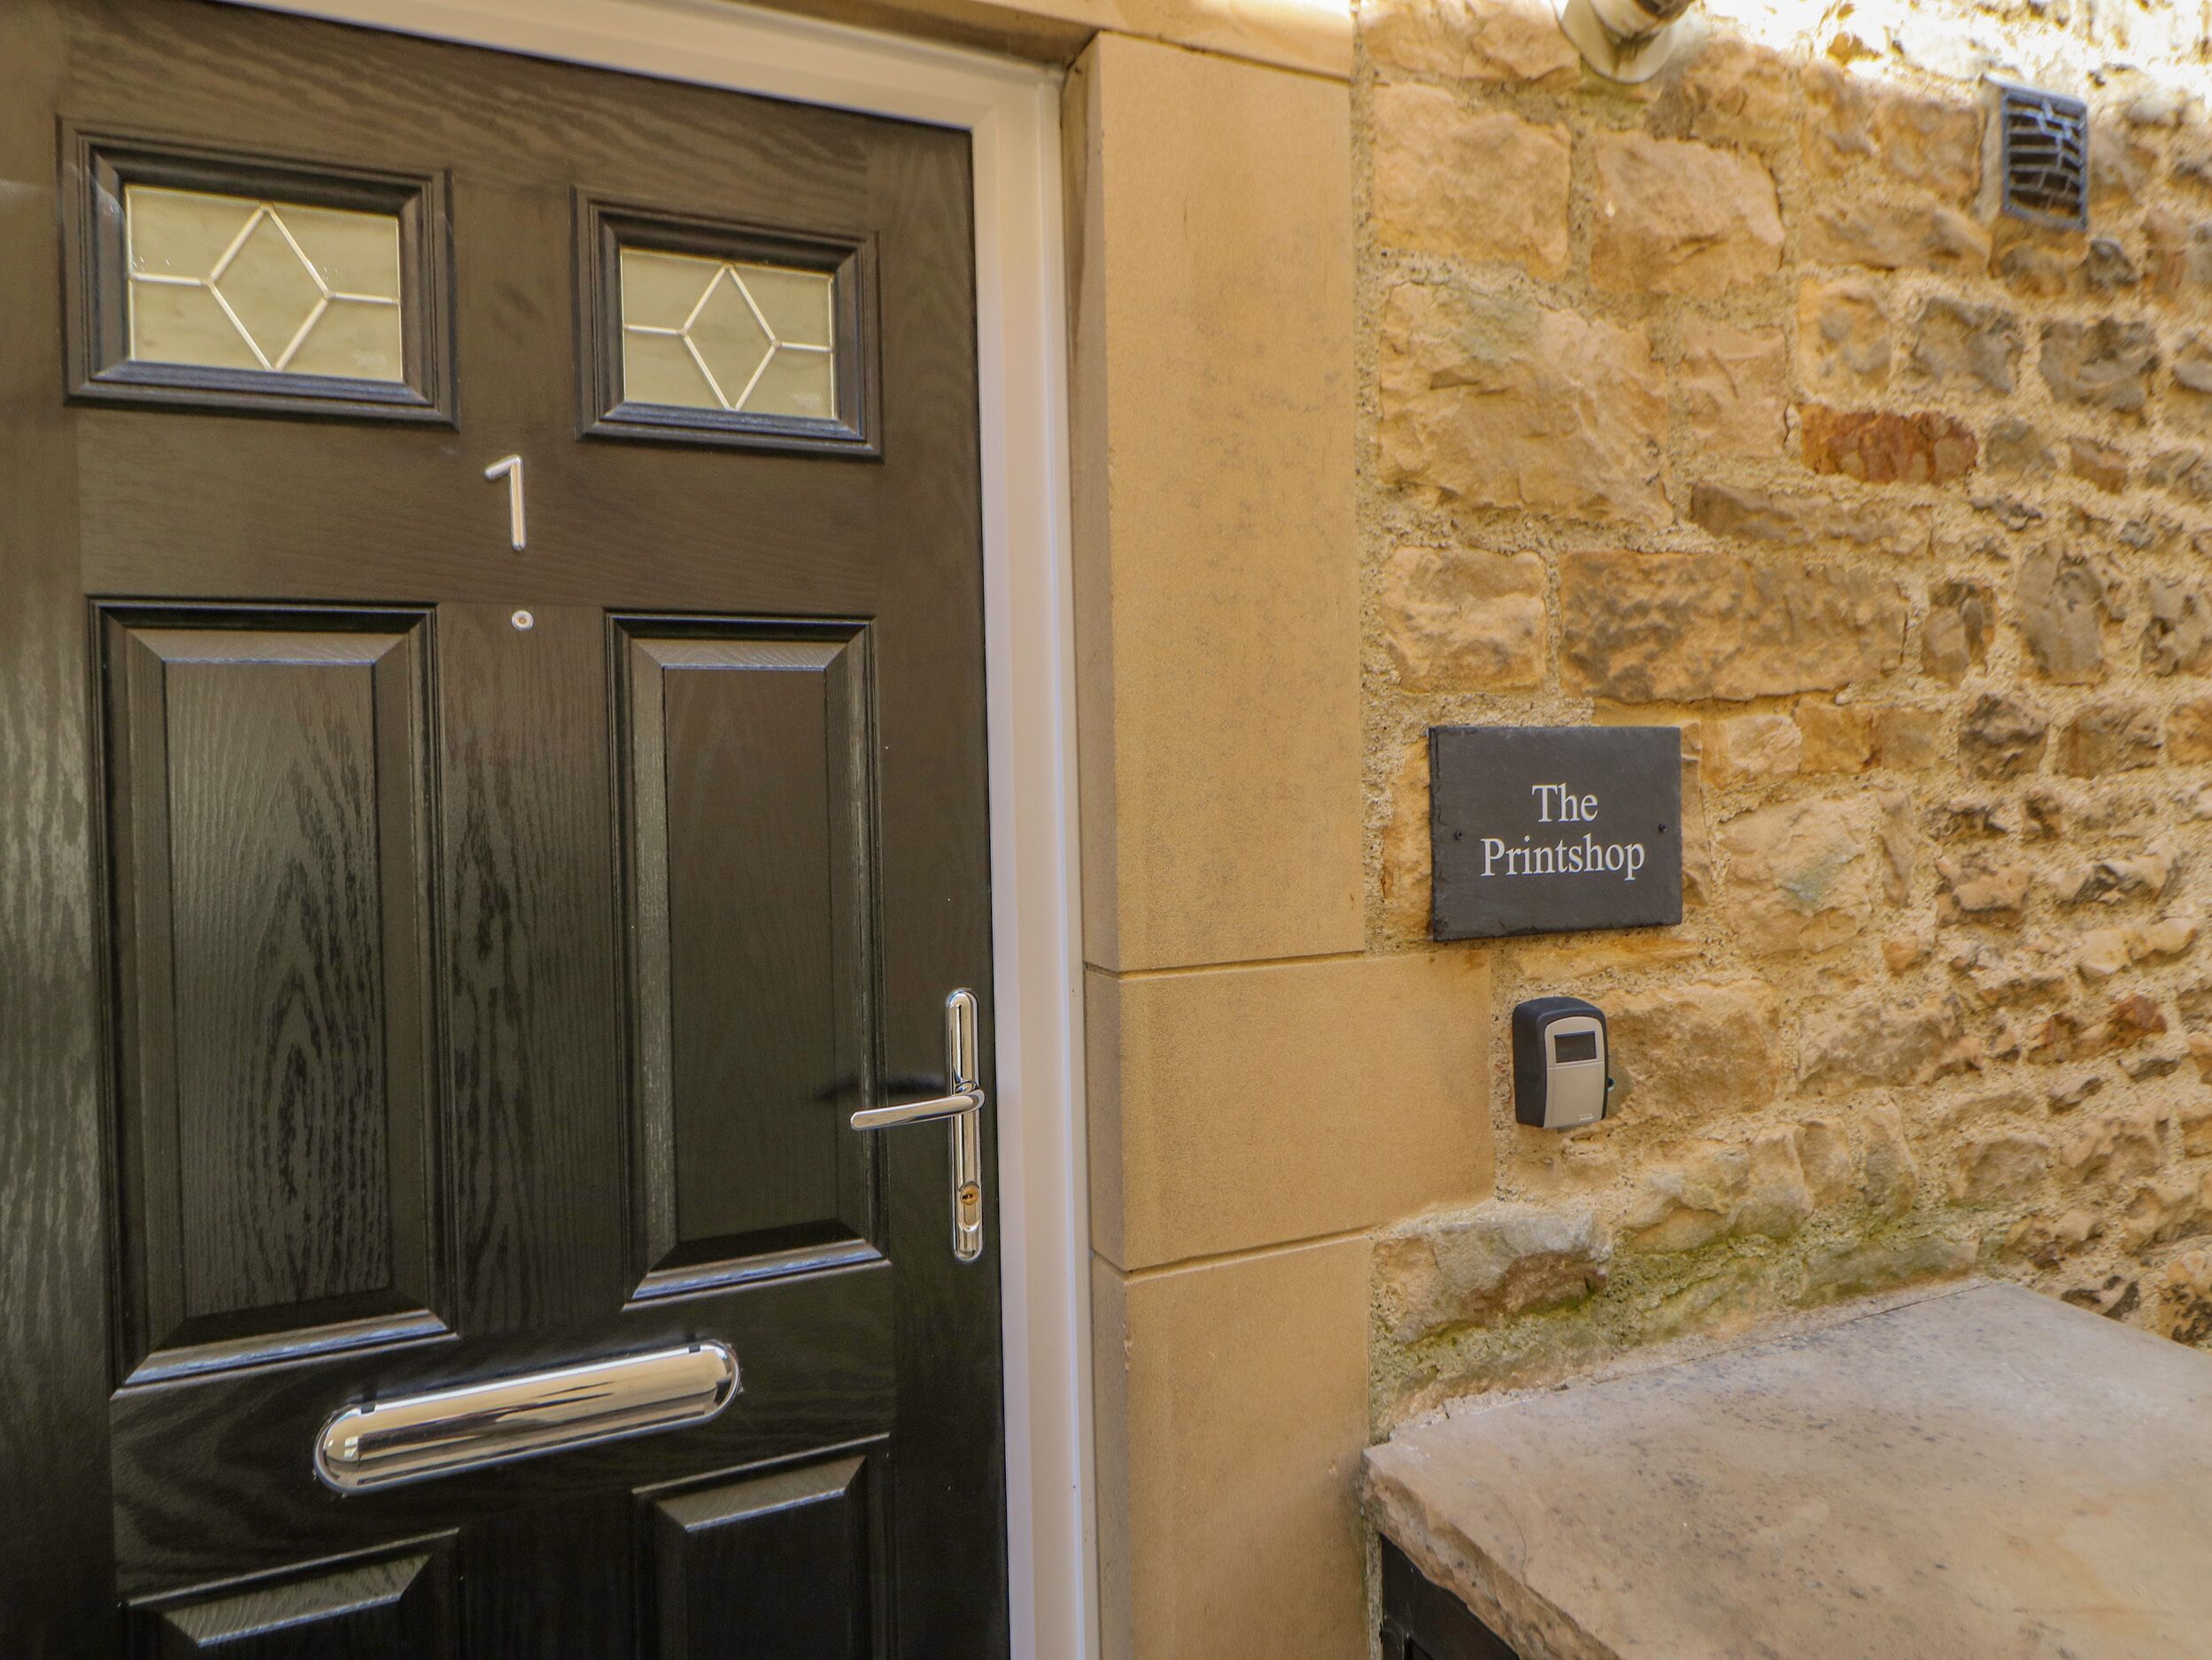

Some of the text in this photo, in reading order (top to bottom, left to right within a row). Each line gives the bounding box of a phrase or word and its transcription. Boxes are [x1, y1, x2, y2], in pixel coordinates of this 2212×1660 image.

[484, 454, 527, 552] 1
[1532, 783, 1598, 822] The
[1480, 833, 1645, 881] Printshop
